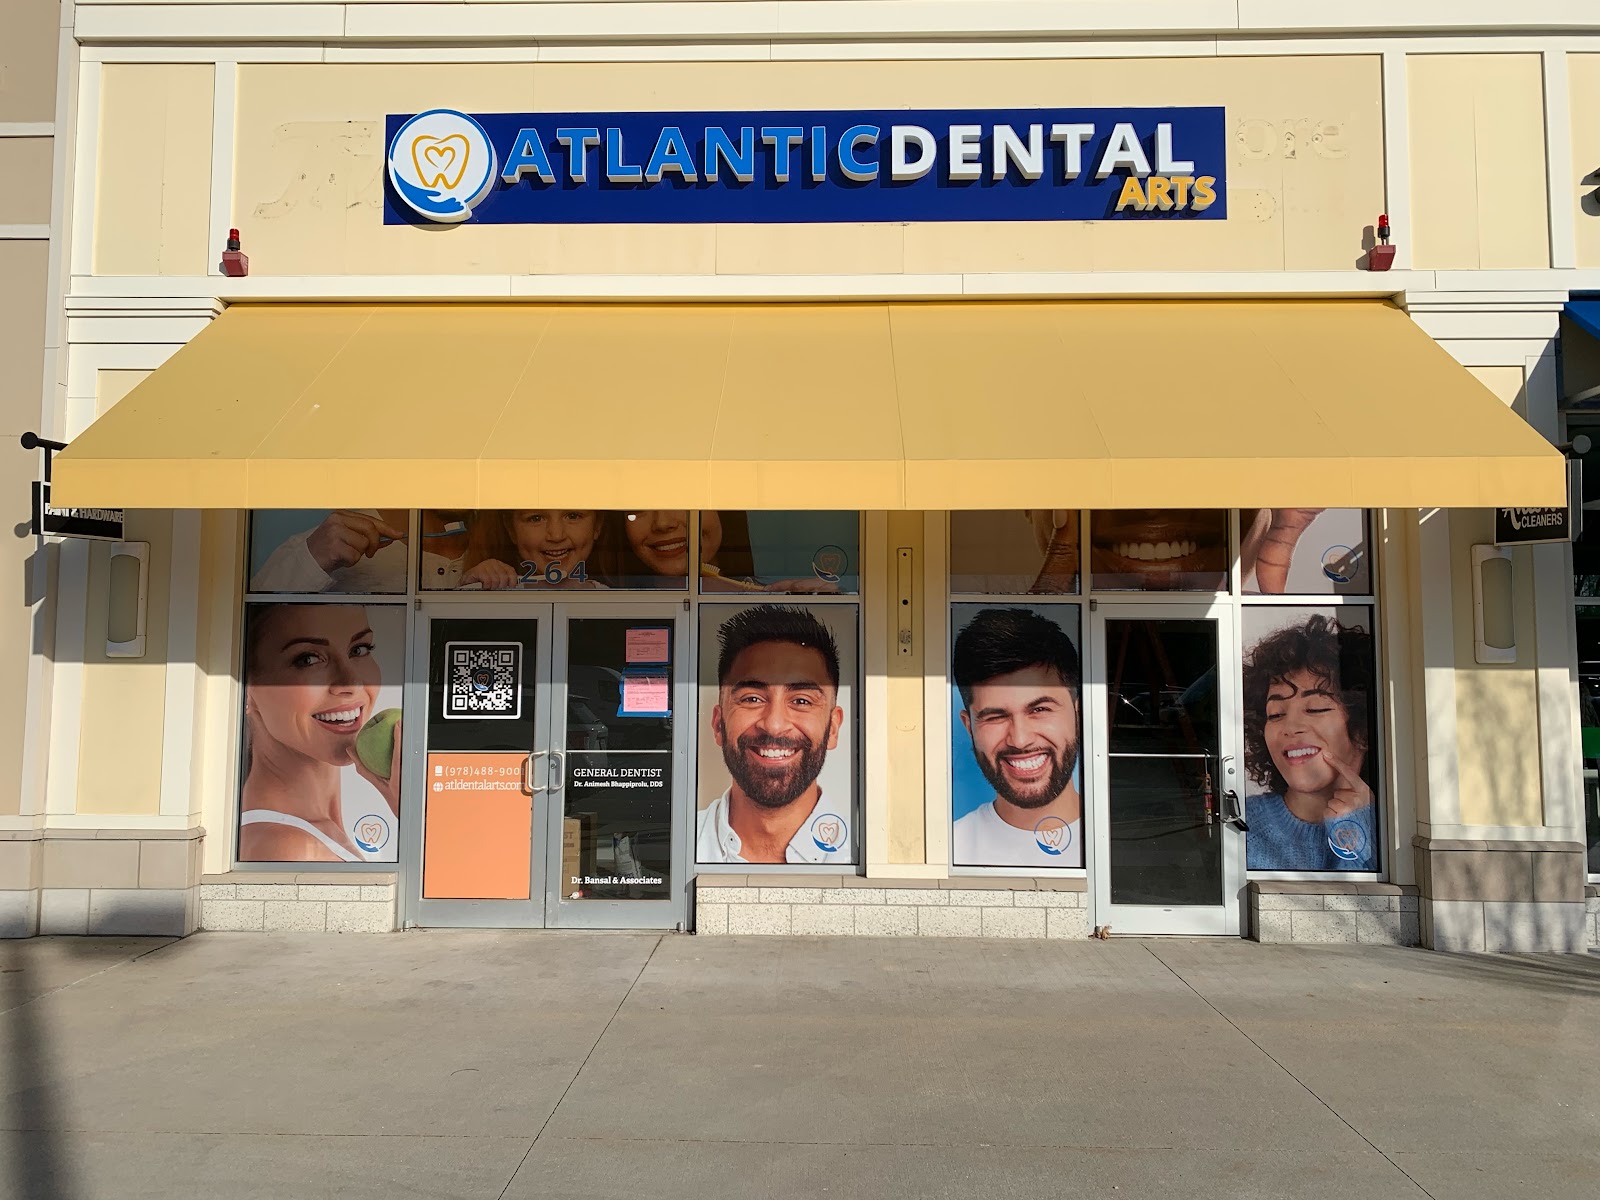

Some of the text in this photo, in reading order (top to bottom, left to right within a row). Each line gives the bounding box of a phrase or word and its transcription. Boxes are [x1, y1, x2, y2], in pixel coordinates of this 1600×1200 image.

[1116, 176, 1217, 211] ARTS
[79, 508, 124, 523] HARDWARE
[1521, 513, 1563, 528] CLEANERS
[520, 560, 588, 584] 264
[573, 768, 662, 777] GENERAL DENTIST
[571, 876, 662, 884] Dr. Bansal & Associates
